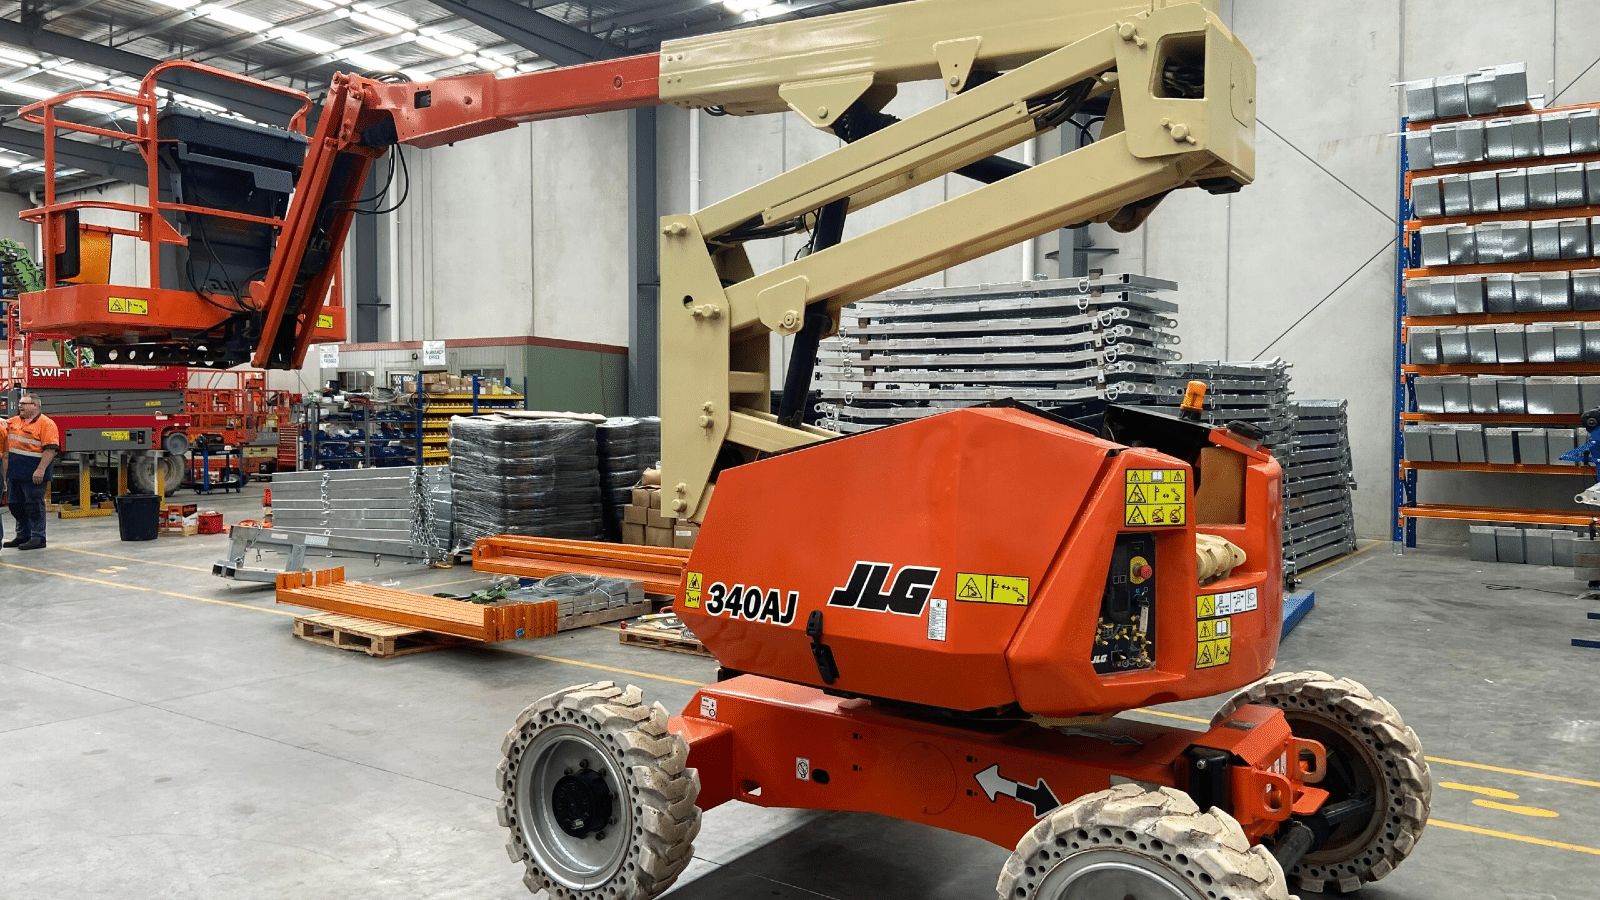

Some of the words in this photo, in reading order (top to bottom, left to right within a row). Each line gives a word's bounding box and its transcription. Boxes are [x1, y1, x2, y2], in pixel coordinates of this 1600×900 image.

[32, 367, 72, 377] SWIFT
[827, 561, 940, 617] JLG
[706, 582, 799, 627] 340AJ
[1091, 654, 1108, 664] JLG
